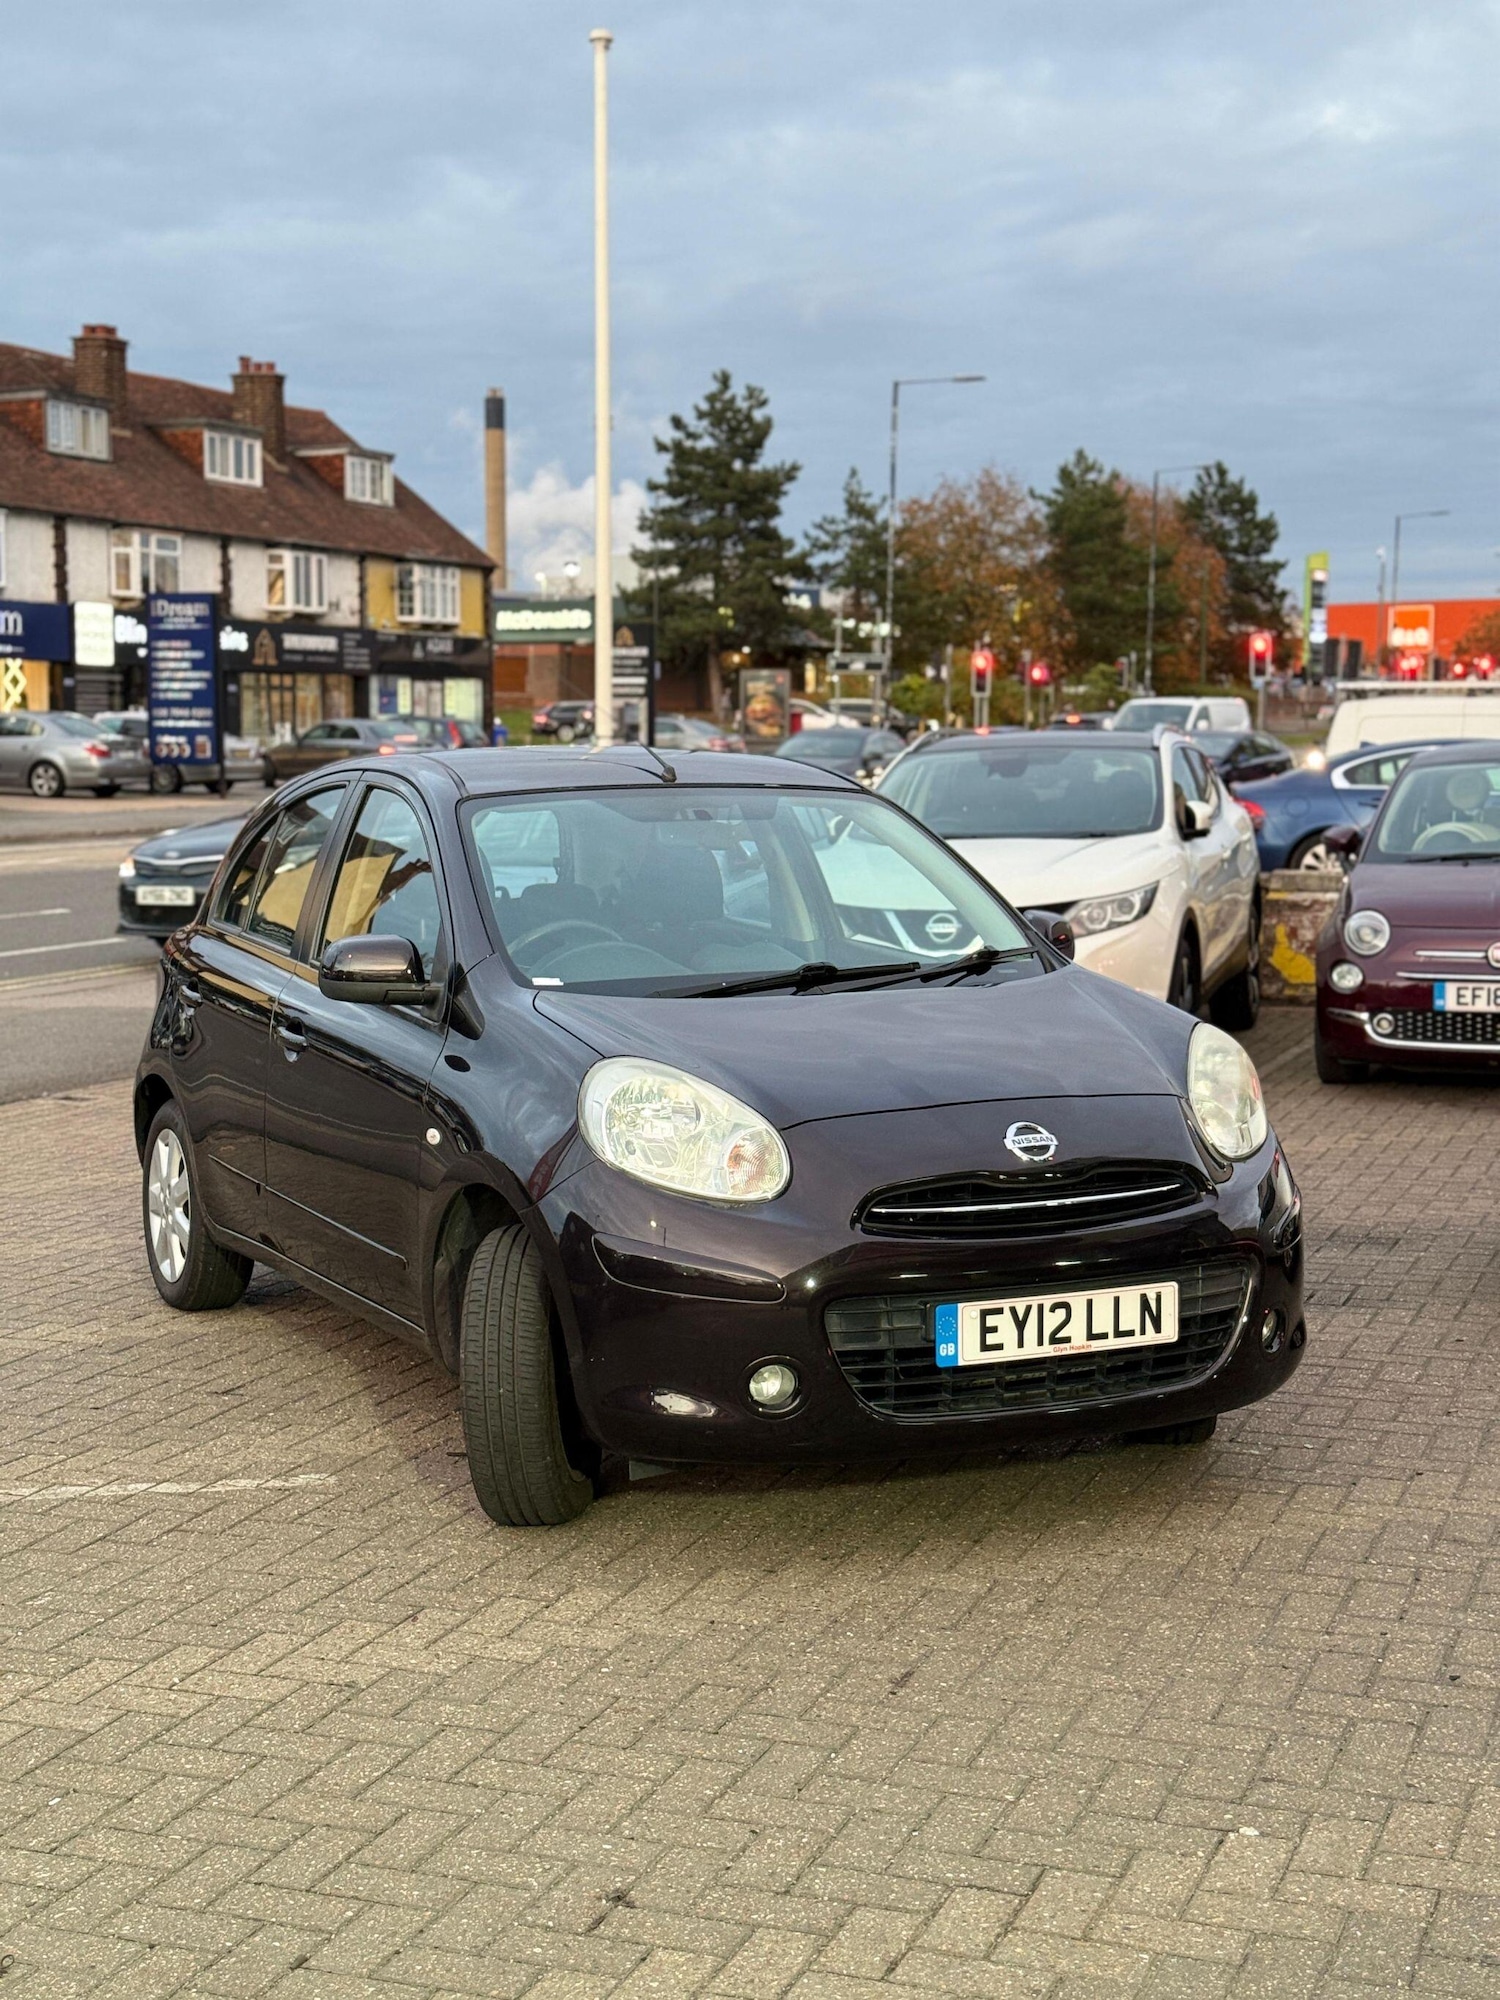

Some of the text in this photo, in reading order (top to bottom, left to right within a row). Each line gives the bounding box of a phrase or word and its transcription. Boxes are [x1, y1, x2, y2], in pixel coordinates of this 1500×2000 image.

[1011, 1136, 1054, 1146] NISSAN
[979, 1291, 1162, 1352] EY12 LLN
[940, 1343, 956, 1356] GB
